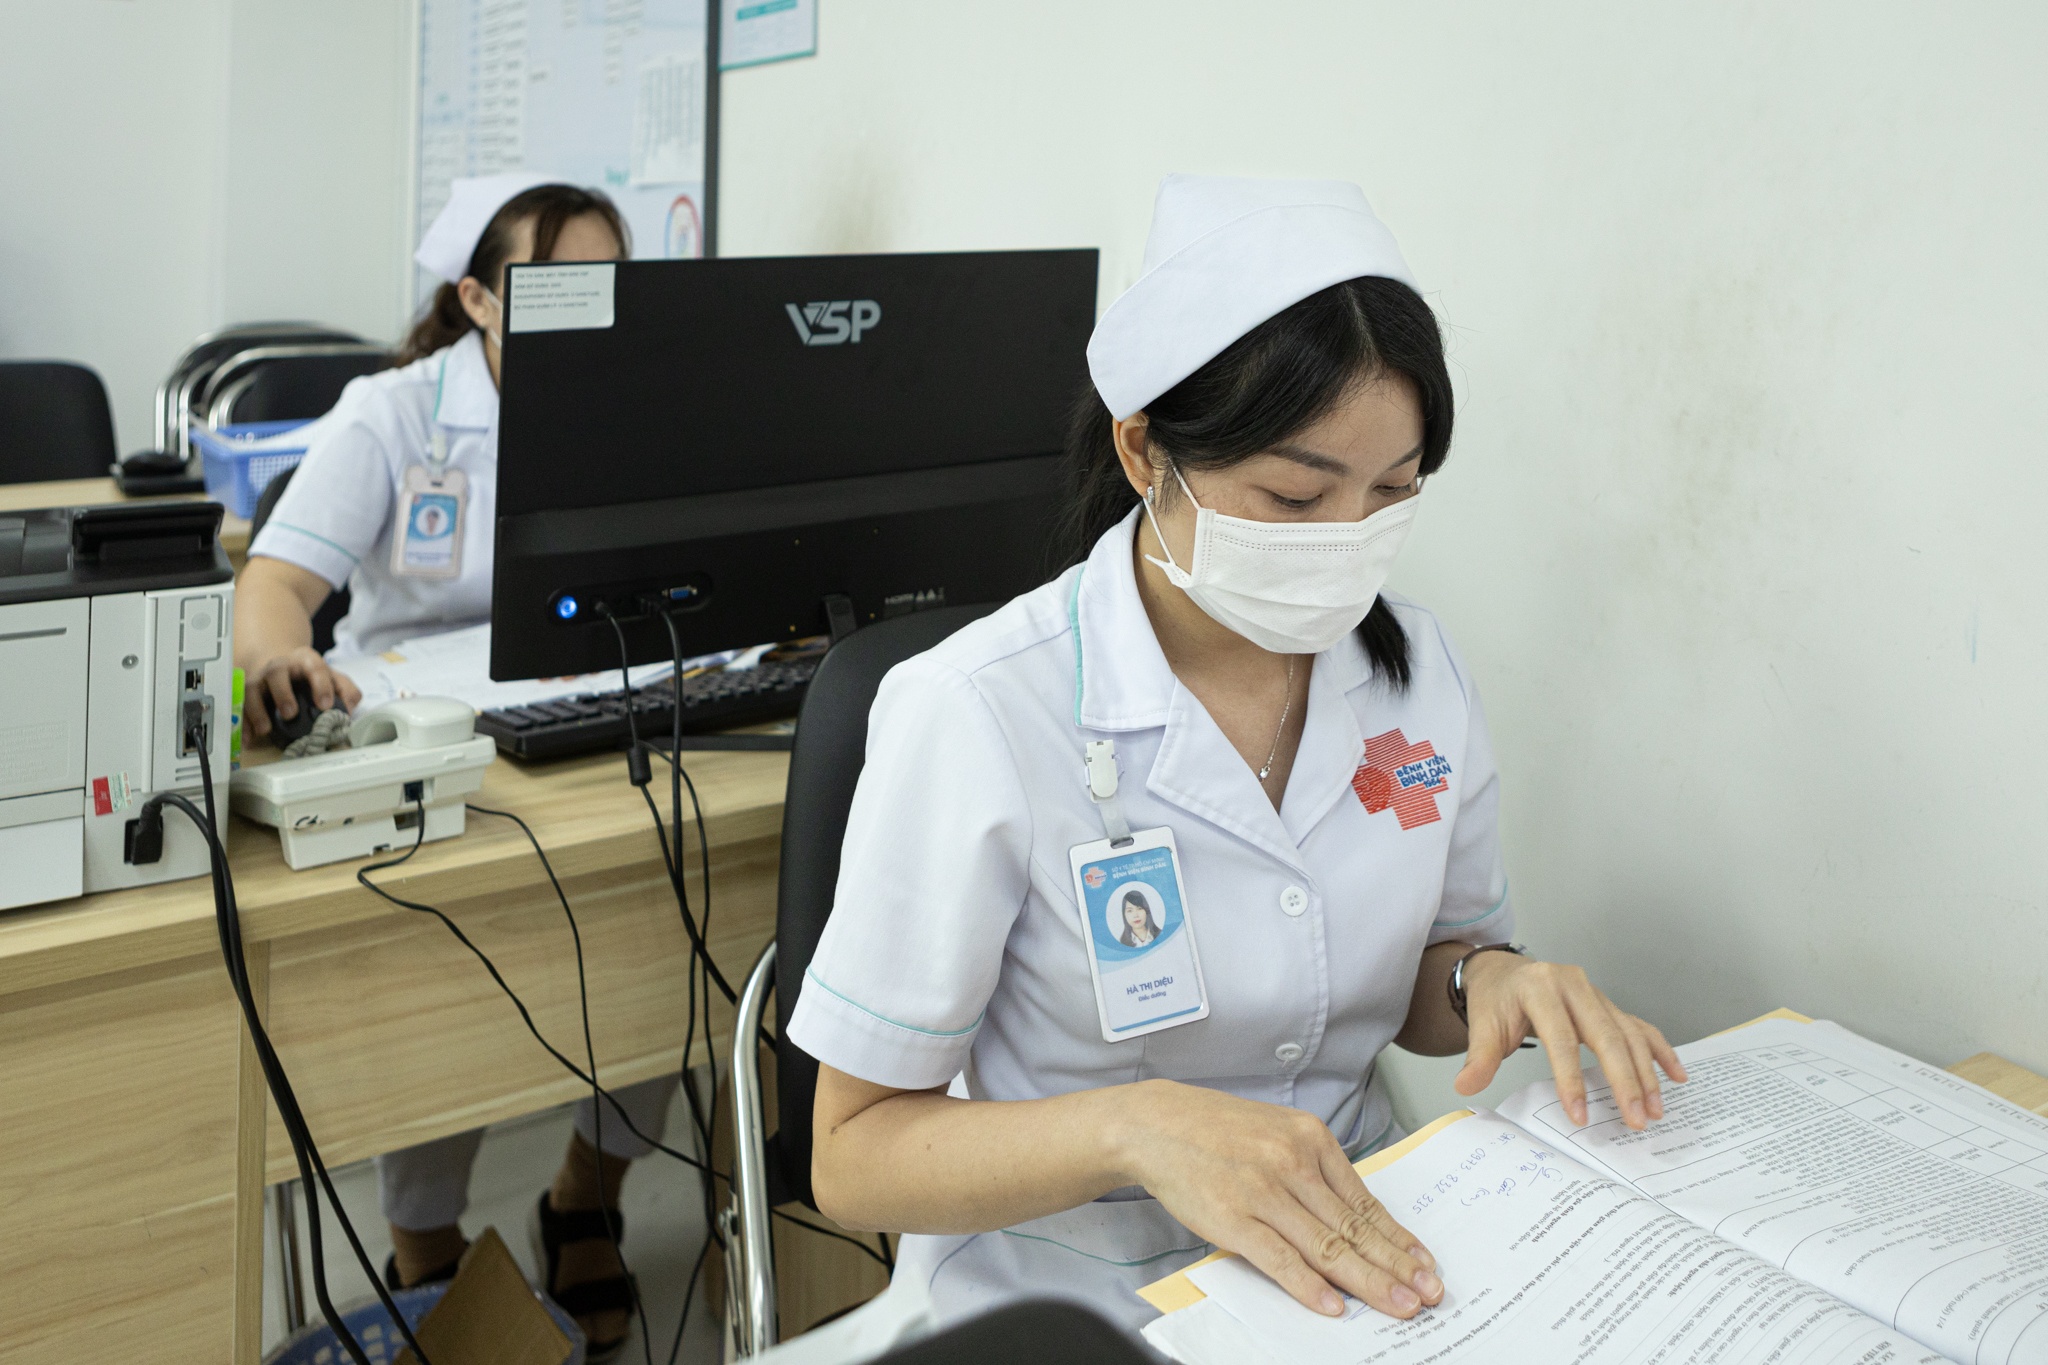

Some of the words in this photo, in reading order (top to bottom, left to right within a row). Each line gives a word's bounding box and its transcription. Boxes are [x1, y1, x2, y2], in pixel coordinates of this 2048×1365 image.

[785, 299, 881, 346] VSP
[1126, 984, 1139, 995] HÀ
[1139, 982, 1153, 991] THỊ
[1154, 976, 1174, 988] DIỆU
